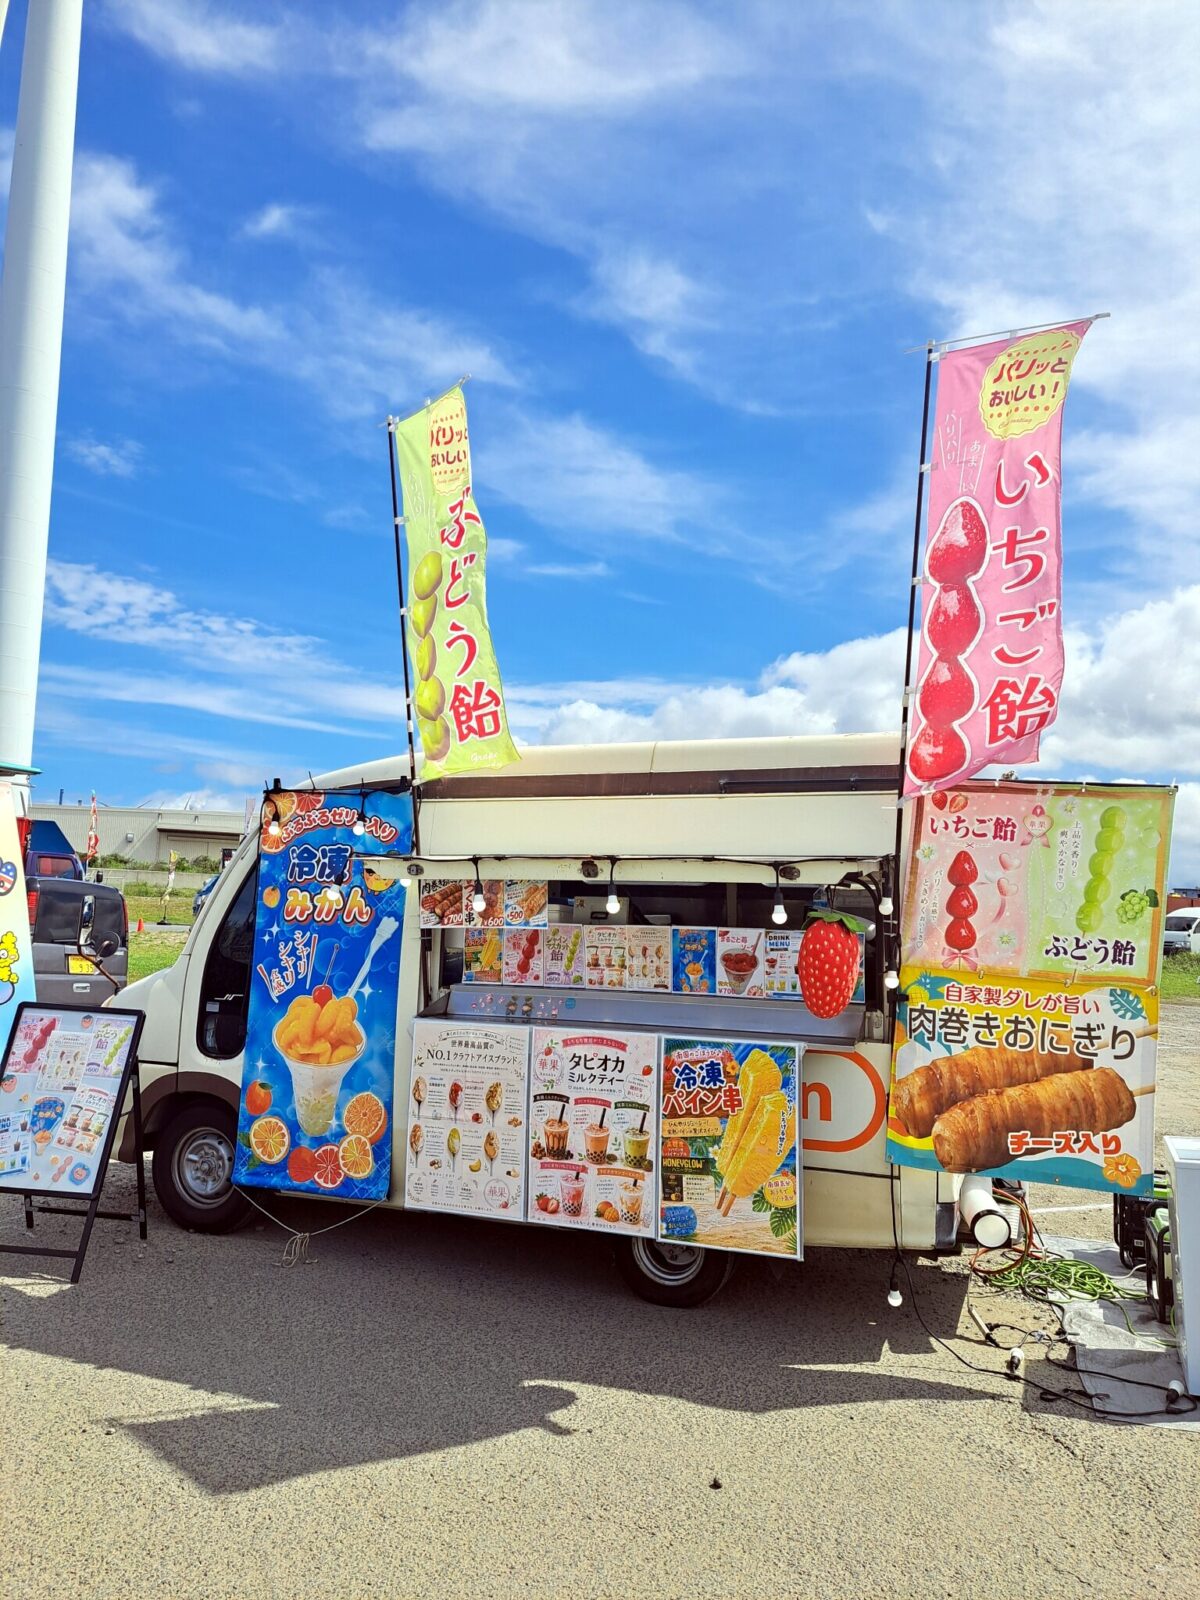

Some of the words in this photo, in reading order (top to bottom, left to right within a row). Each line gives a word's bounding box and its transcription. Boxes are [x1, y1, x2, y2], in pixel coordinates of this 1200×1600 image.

[993, 357, 1068, 384] パリッと
[989, 381, 1060, 407] おいしい!
[440, 486, 501, 743] ぶどう飴
[981, 453, 1057, 746] いちご飴
[282, 807, 396, 842] ぷるぷるゼリ入り
[930, 815, 1017, 842] いちご飴
[288, 844, 351, 882] 冷凍
[284, 887, 372, 922] みかん
[484, 916, 505, 927] ¥600
[1045, 936, 1136, 966] ぶどう飴
[944, 983, 1100, 1014] 自家製ダレが旨い
[907, 1006, 1136, 1060] 肉巻きおにぎり
[569, 1052, 626, 1074] タピオカ
[673, 1060, 726, 1090] 冷凍
[568, 1071, 625, 1086] ミルクティー
[661, 1085, 744, 1115] パイン串
[1009, 1132, 1122, 1155] チーズ入り
[662, 1158, 703, 1169] HONEYGLOW
